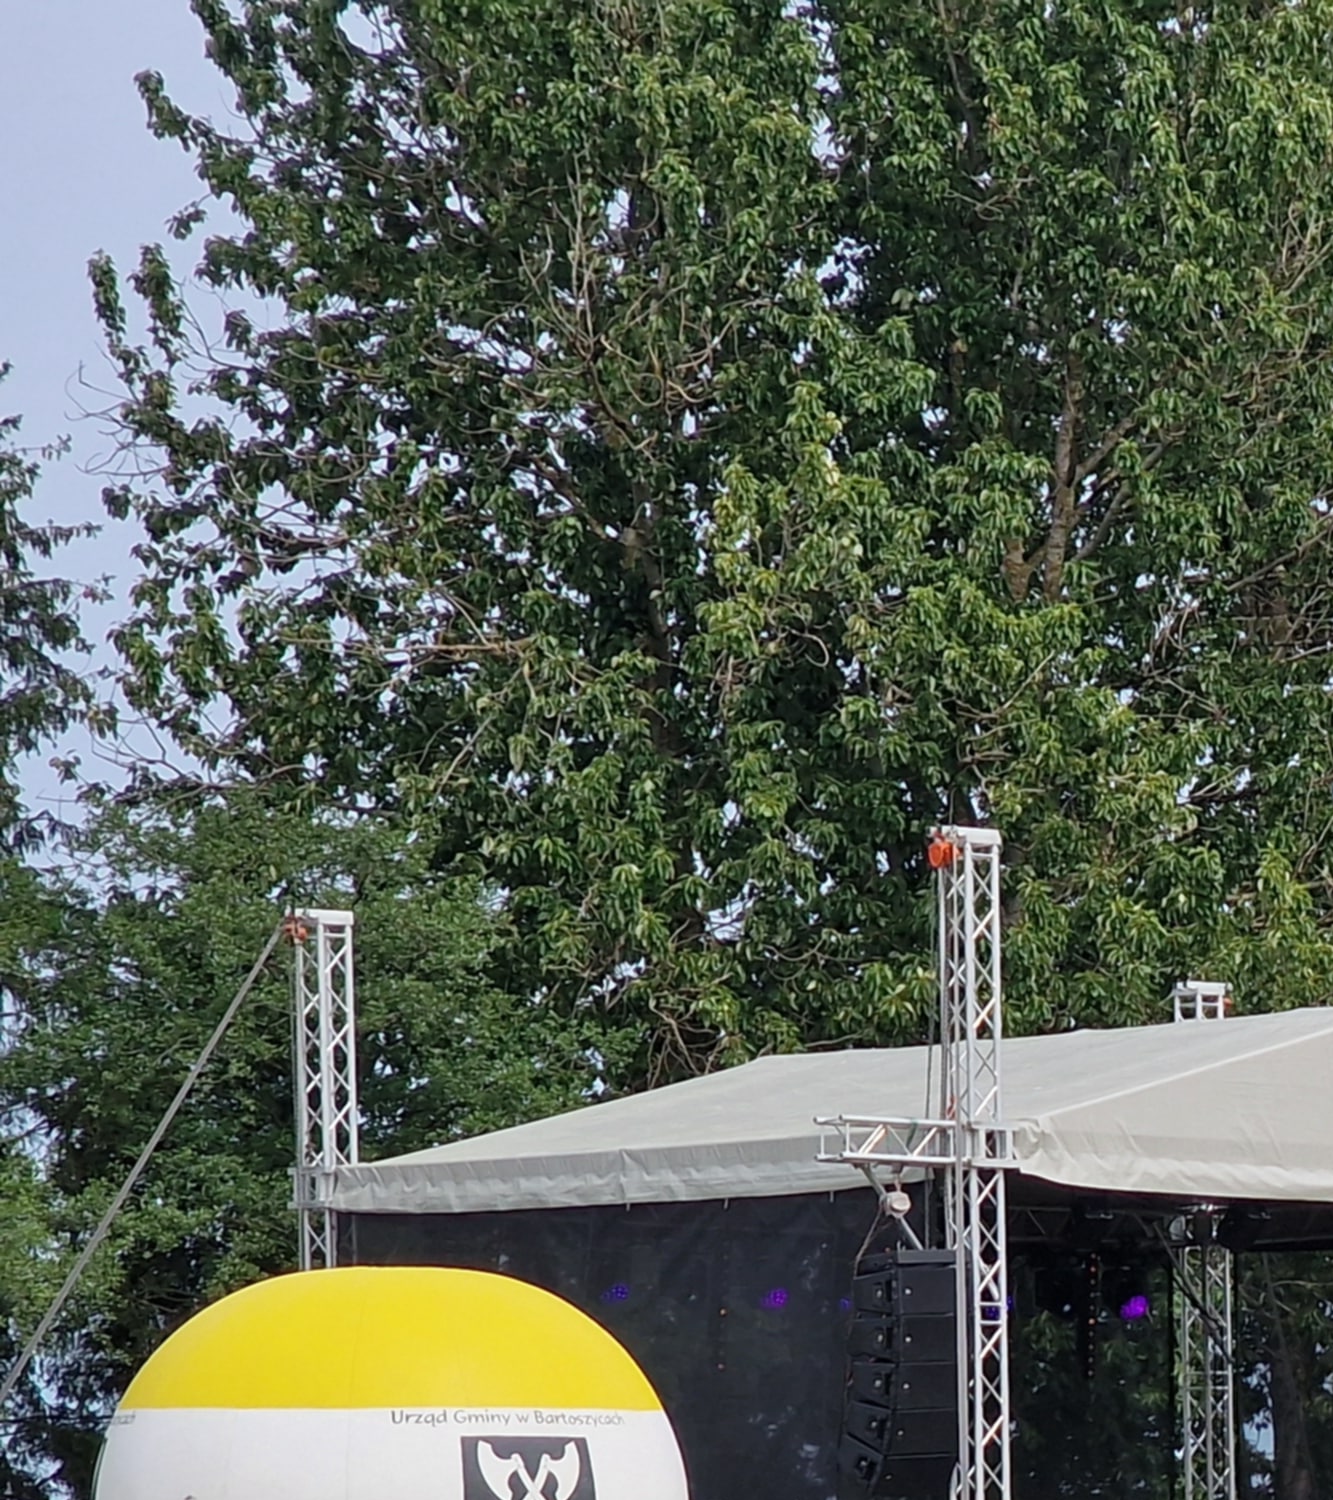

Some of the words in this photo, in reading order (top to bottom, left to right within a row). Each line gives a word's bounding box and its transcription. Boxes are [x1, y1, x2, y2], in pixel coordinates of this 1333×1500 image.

[453, 1409, 511, 1426] Gminy
[515, 1413, 530, 1424] w
[533, 1410, 625, 1428] Bartoszycach
